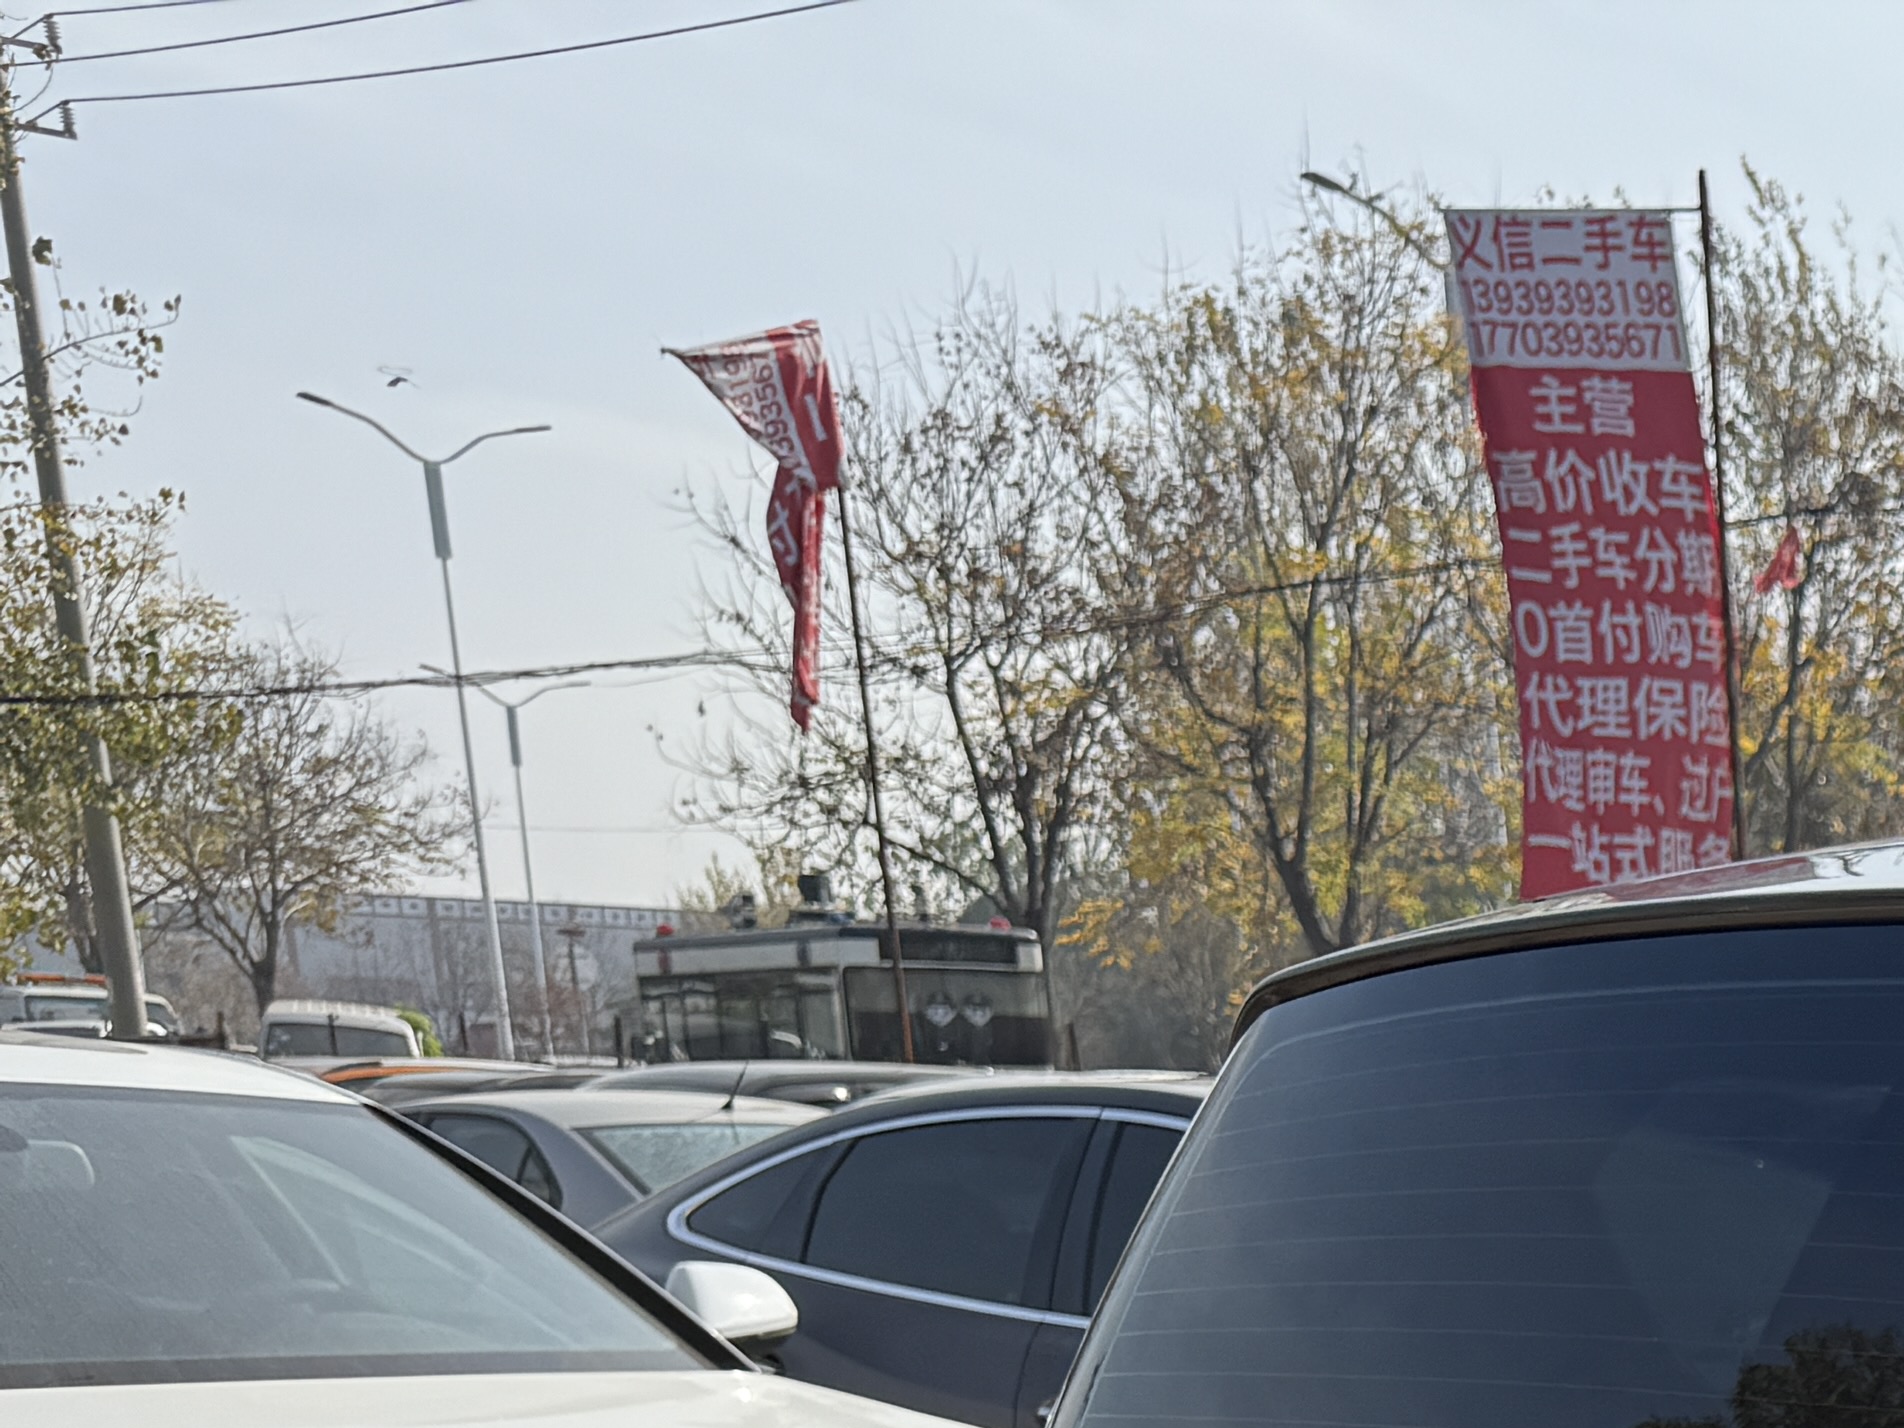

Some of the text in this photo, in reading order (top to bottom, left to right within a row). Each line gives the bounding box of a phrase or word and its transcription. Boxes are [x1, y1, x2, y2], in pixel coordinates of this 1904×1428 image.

[1451, 213, 1672, 273] 义信二手车
[1461, 278, 1679, 319] 13939393198
[1469, 319, 1684, 361] 17703935671
[1529, 372, 1637, 438] 主营
[1492, 446, 1709, 524] 高价收车
[1507, 521, 1719, 597] 二手车分期
[1524, 671, 1730, 745] 代理保险
